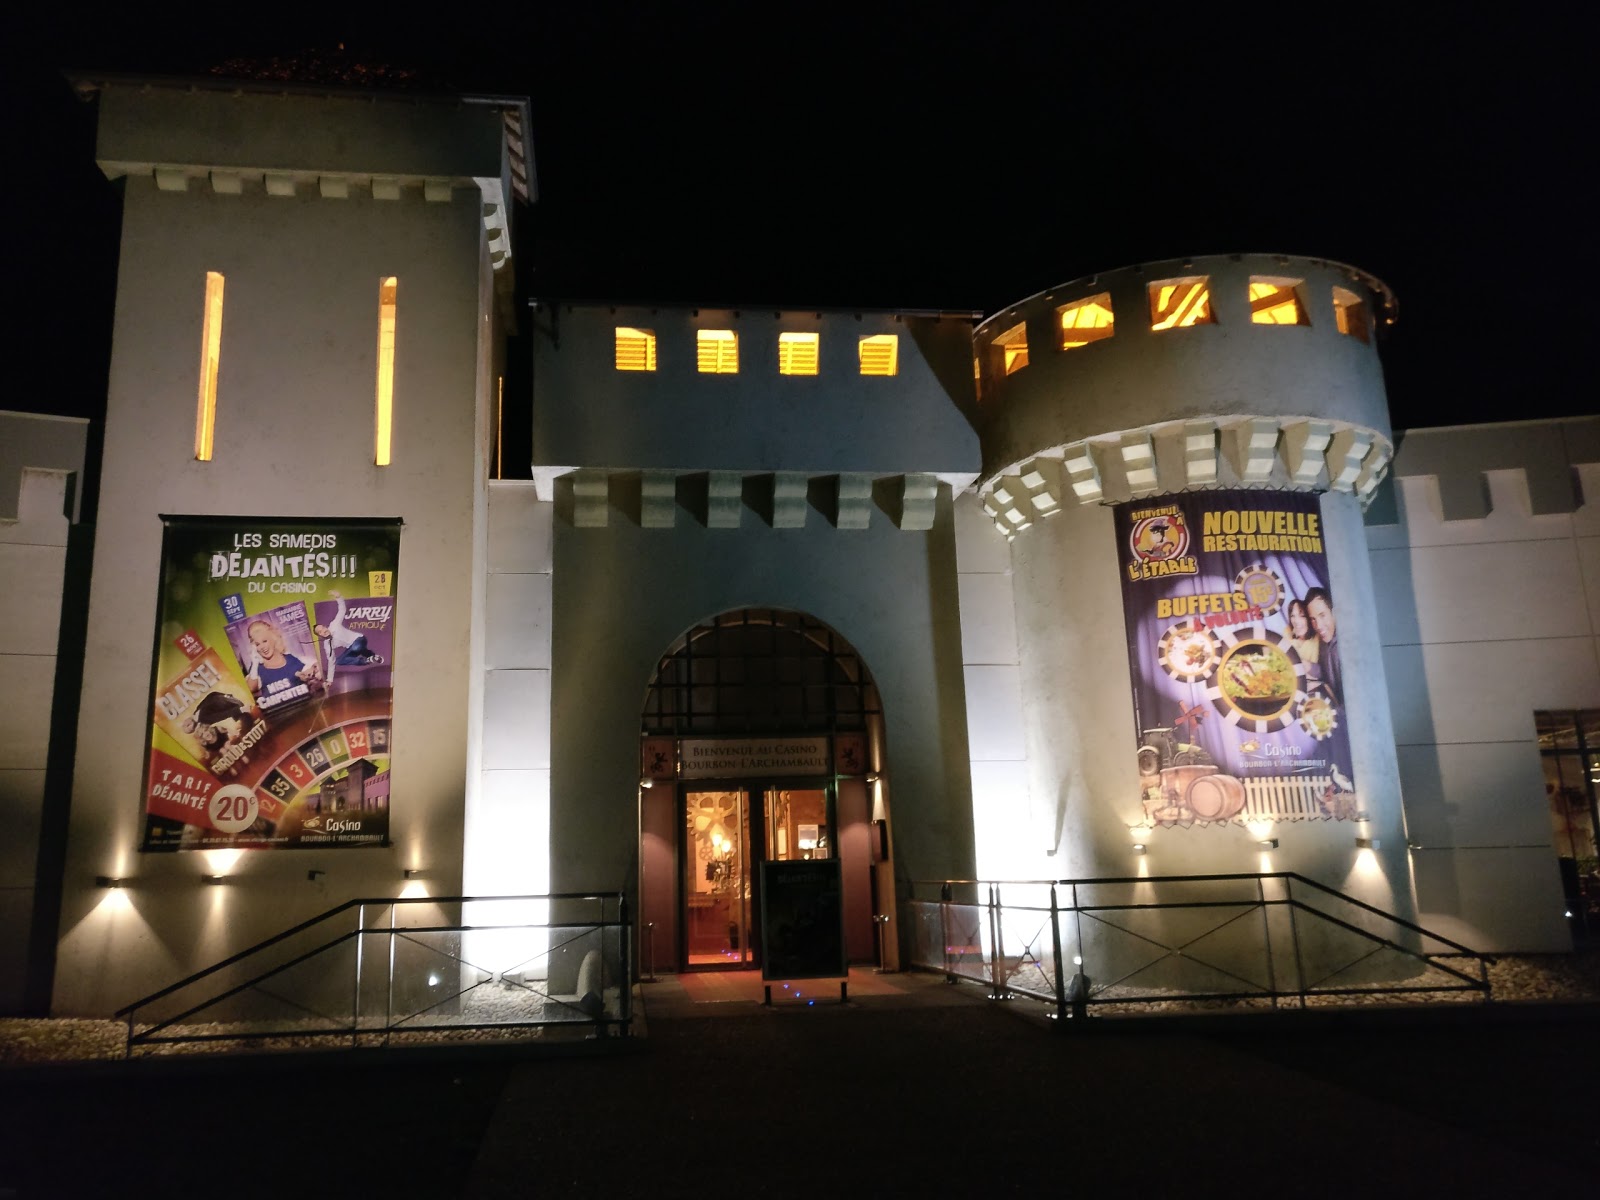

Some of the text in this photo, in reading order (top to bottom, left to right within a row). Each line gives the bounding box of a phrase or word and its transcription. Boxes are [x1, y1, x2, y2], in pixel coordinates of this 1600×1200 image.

[1131, 505, 1178, 521] BIENVENUE
[1203, 510, 1320, 536] NOUVELLE
[234, 533, 337, 549] LES SAMEDIS
[1203, 534, 1323, 554] RESTAURATION
[211, 548, 356, 578] DÉJANTÉS!!!
[1129, 557, 1197, 580] L'ÉTABLE
[247, 581, 317, 594] DU CASINO
[223, 596, 238, 610] 30
[1157, 592, 1249, 619] BUFFETS
[279, 609, 305, 624] JAMES
[344, 605, 393, 623] JARRY
[180, 634, 195, 648] 26
[159, 659, 222, 720] CLASSE!
[266, 678, 291, 694] MISS
[329, 739, 342, 755] 0
[349, 731, 366, 749] 32
[306, 748, 324, 768] 26
[289, 764, 304, 778] 3
[162, 769, 212, 794] TARIF
[270, 777, 290, 797] 35
[152, 783, 207, 810] DÉJANTÉ
[325, 818, 361, 833] Casino
